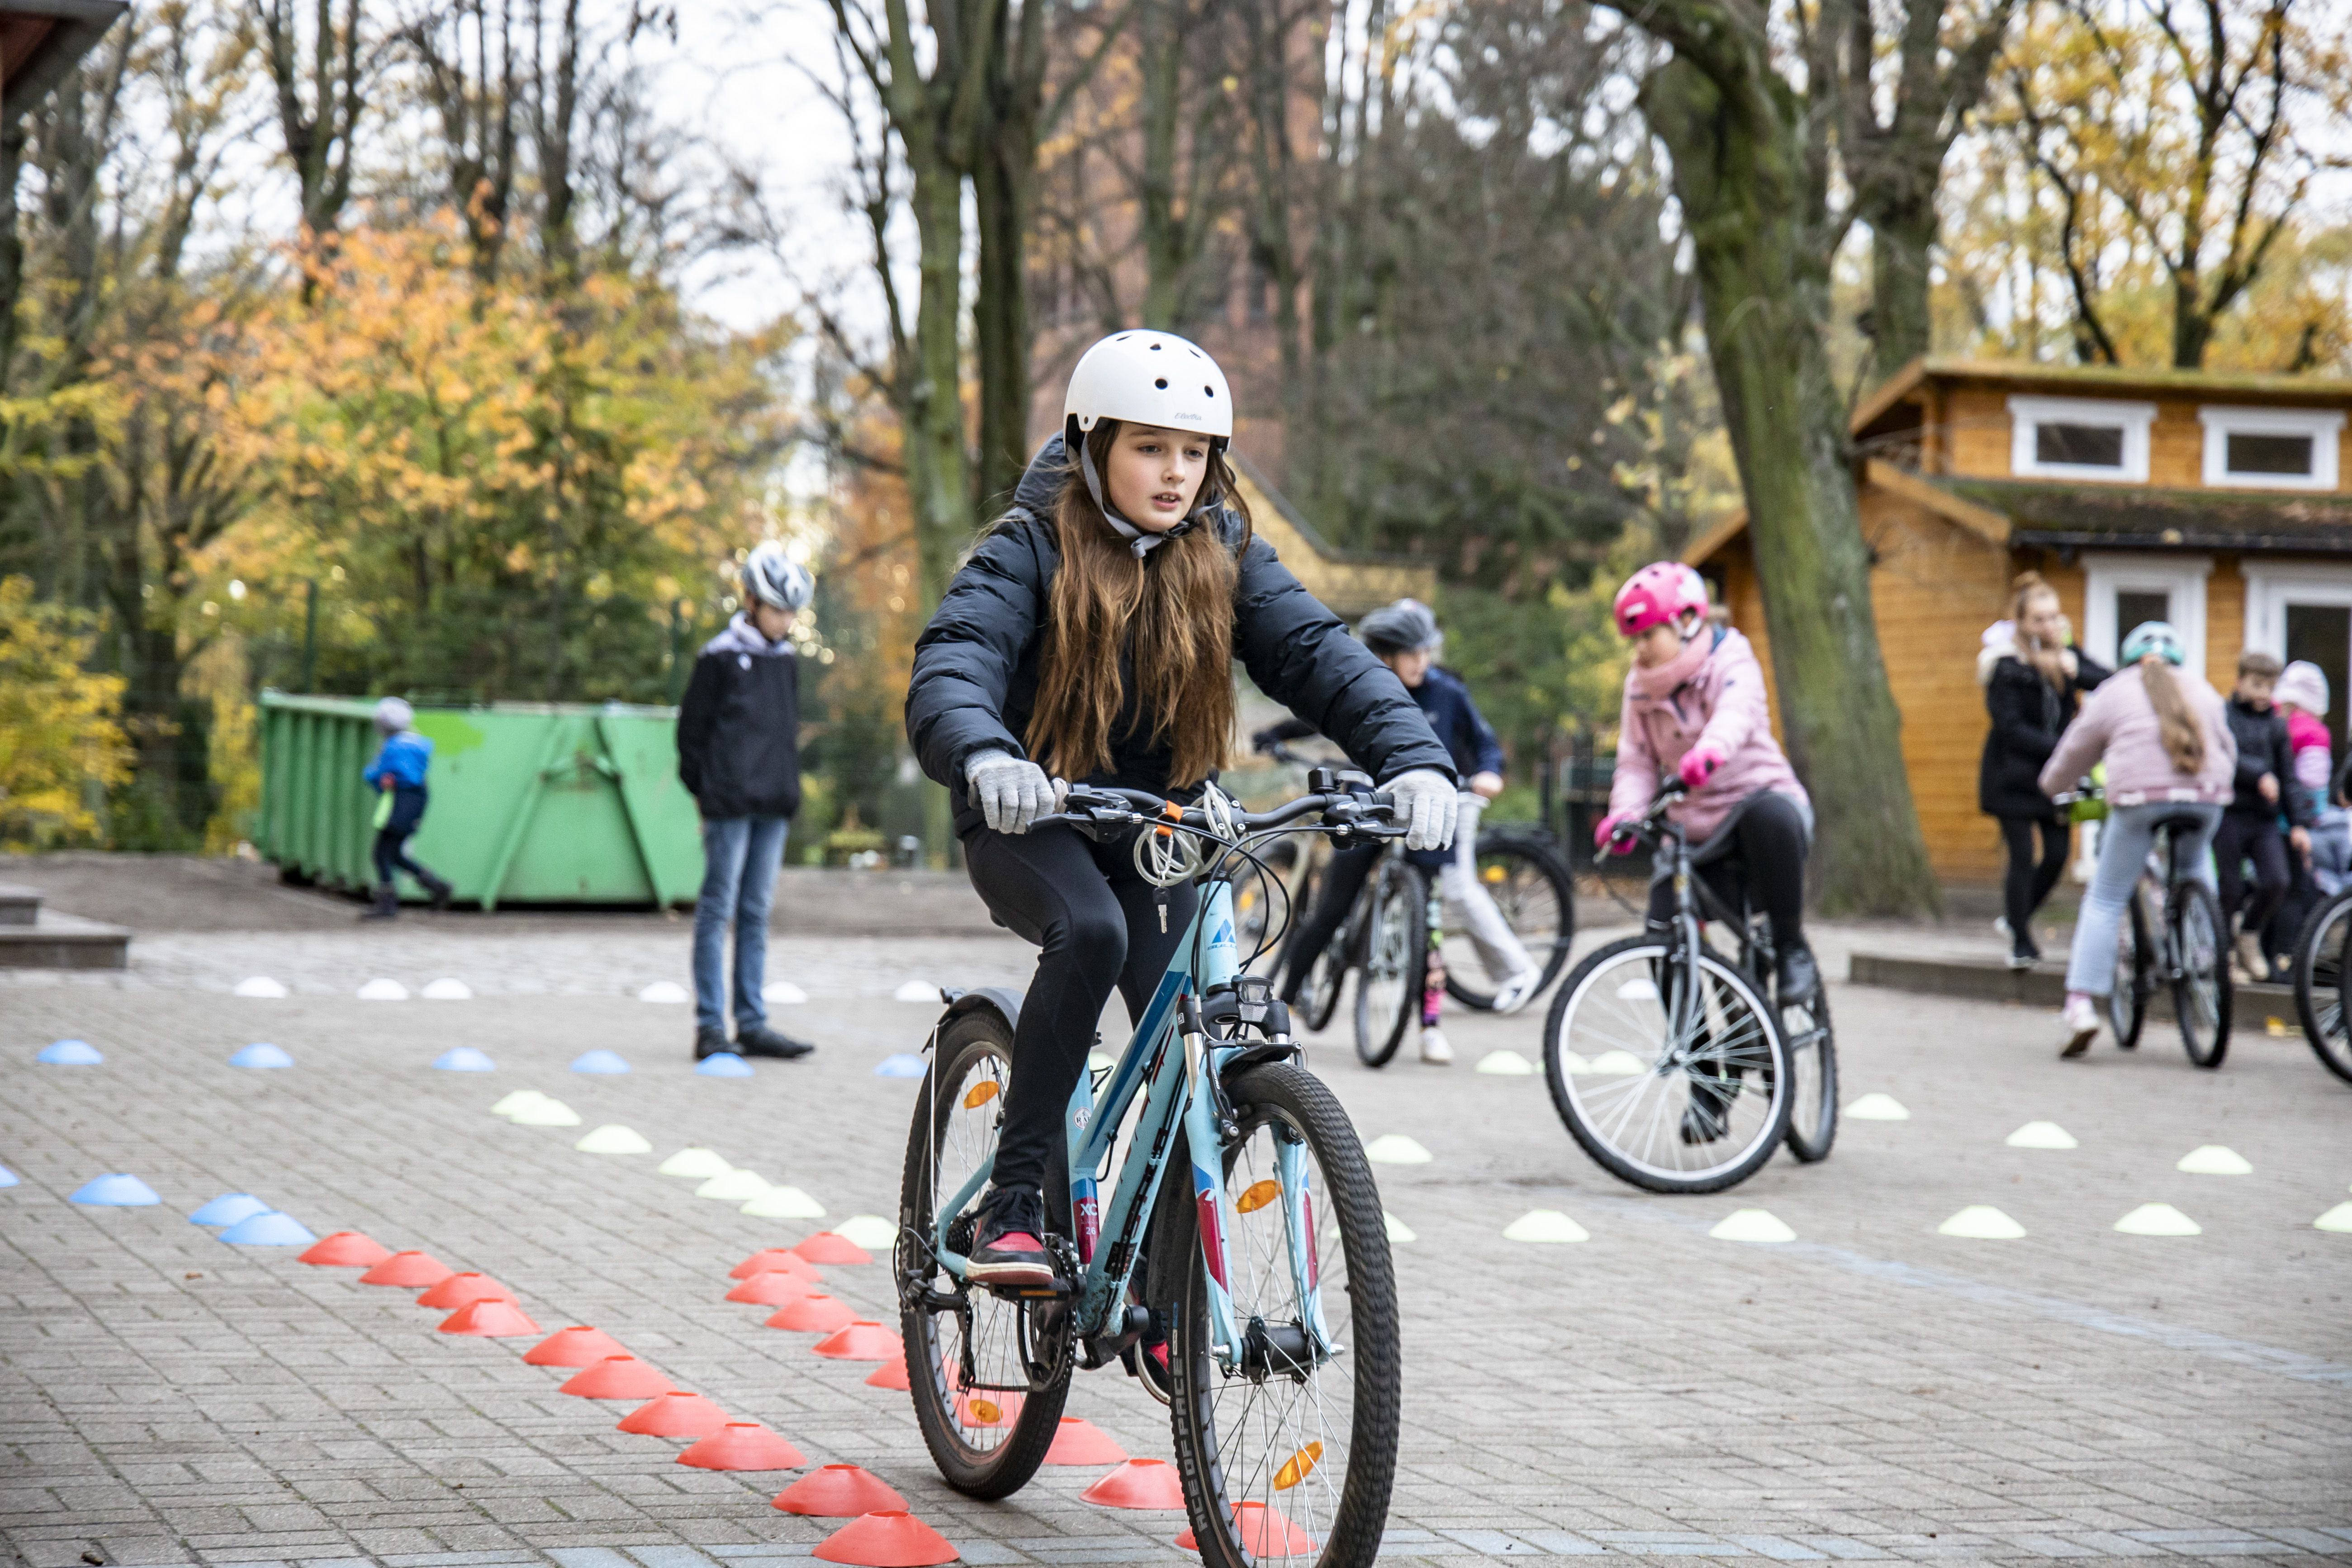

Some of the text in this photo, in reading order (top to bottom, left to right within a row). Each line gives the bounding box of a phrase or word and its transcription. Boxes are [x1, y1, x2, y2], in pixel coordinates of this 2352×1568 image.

[1080, 1203, 1097, 1216] XC
[1086, 1227, 1096, 1235] 26
[1173, 1357, 1208, 1532] ACE OF PACE
